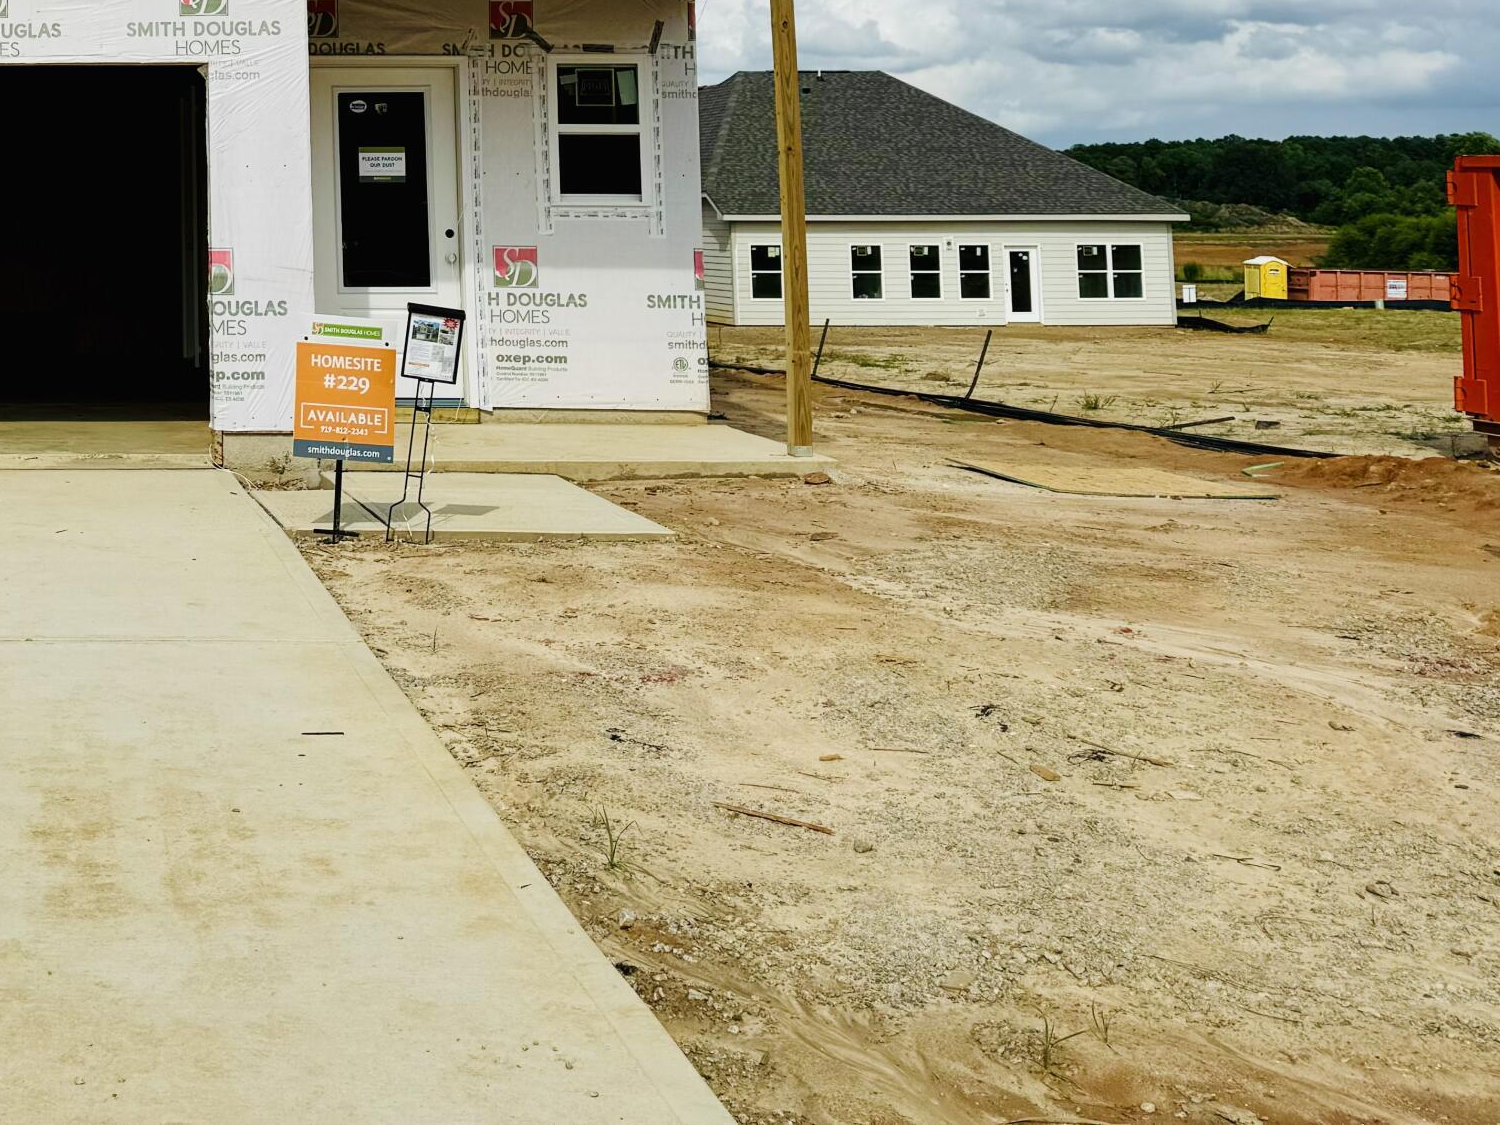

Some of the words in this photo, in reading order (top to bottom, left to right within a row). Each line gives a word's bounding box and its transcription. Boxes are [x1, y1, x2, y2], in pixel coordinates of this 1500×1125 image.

[126, 22, 186, 37] SMITH
[193, 20, 281, 37] DOUGLAS
[175, 39, 242, 55] HOMES
[308, 43, 387, 55] DOUGLAS
[506, 292, 588, 308] DOUGLAS
[646, 293, 701, 309] SMITH
[490, 309, 551, 324] HOMES
[324, 326, 341, 334] SMITH
[340, 327, 364, 336] DOUGLAS
[363, 329, 381, 337] HOMES
[310, 353, 382, 372] HOMESITE
[495, 353, 568, 366] oxep.com
[323, 373, 371, 395] #229
[307, 409, 383, 426] AVAILABLE
[307, 445, 380, 458] smithdouglas.com
